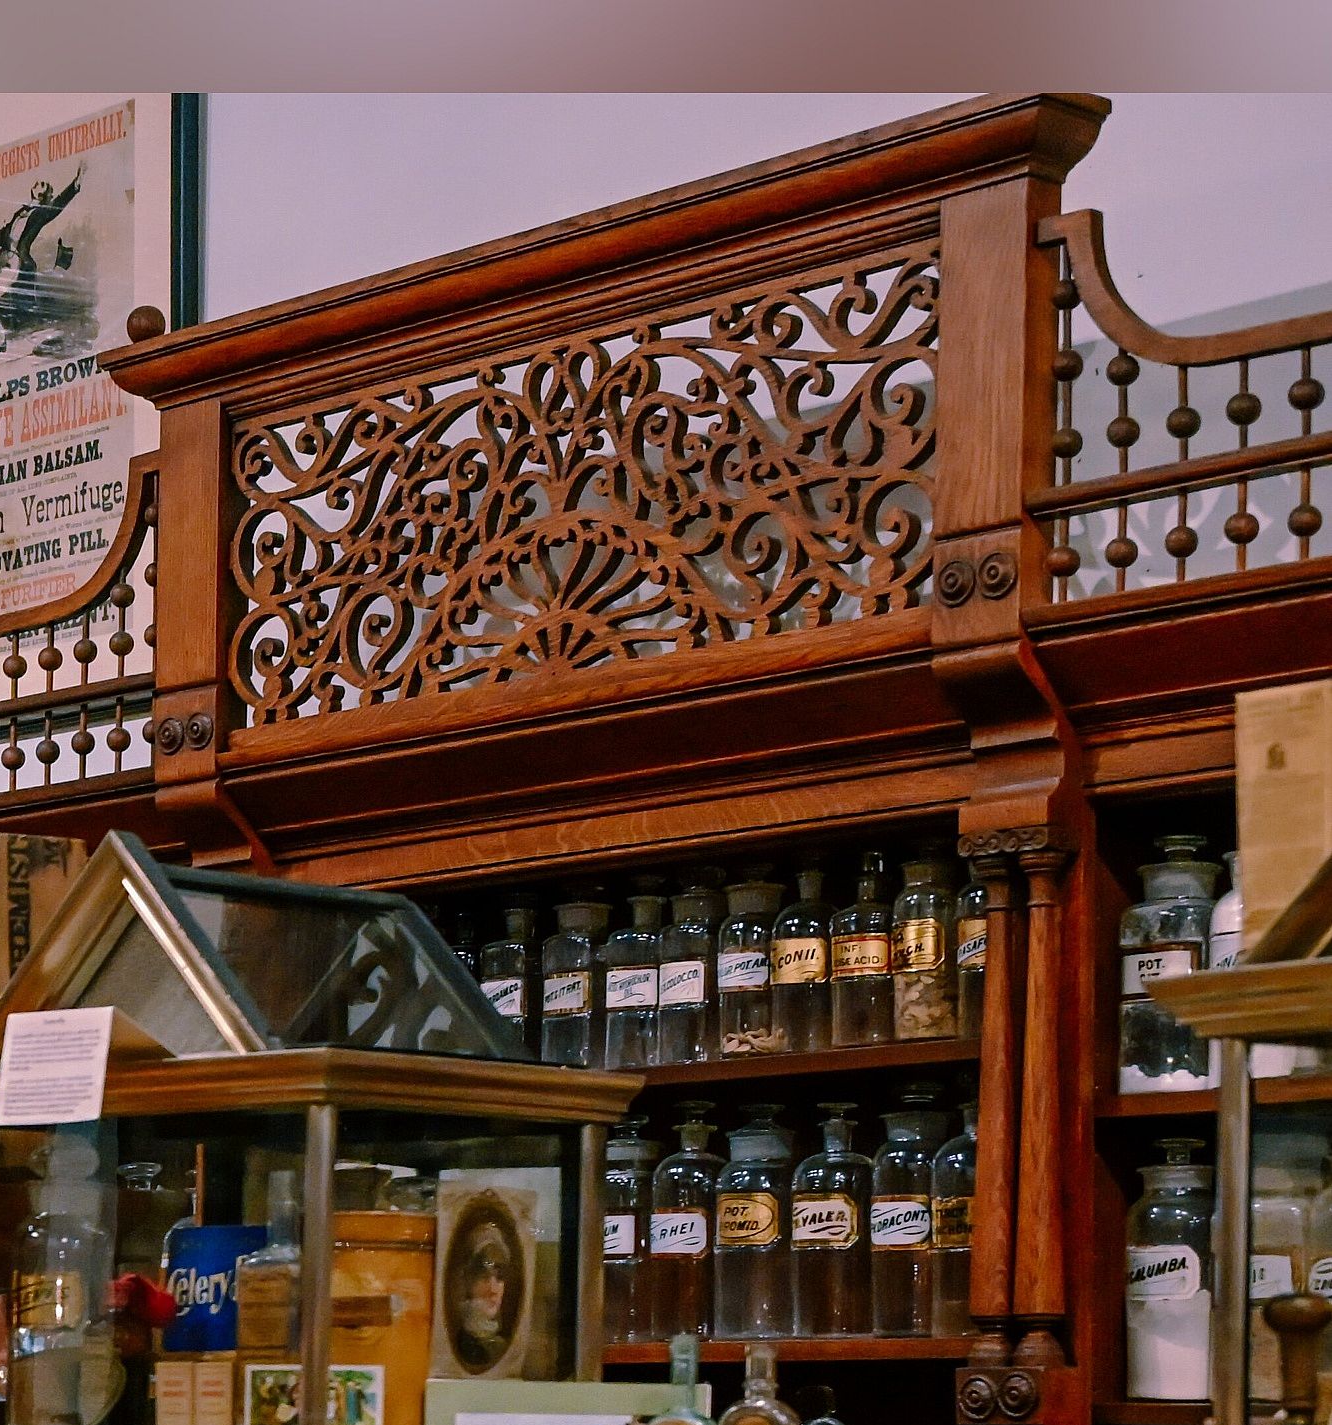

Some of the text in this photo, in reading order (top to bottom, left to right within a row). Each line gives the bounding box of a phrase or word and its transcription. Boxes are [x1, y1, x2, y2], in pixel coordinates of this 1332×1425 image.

[36, 354, 103, 392] BROW
[33, 438, 104, 473] BALSAM,
[1138, 958, 1166, 972] POT.
[660, 1222, 695, 1240] RHEI
[168, 1267, 232, 1317] Celery
